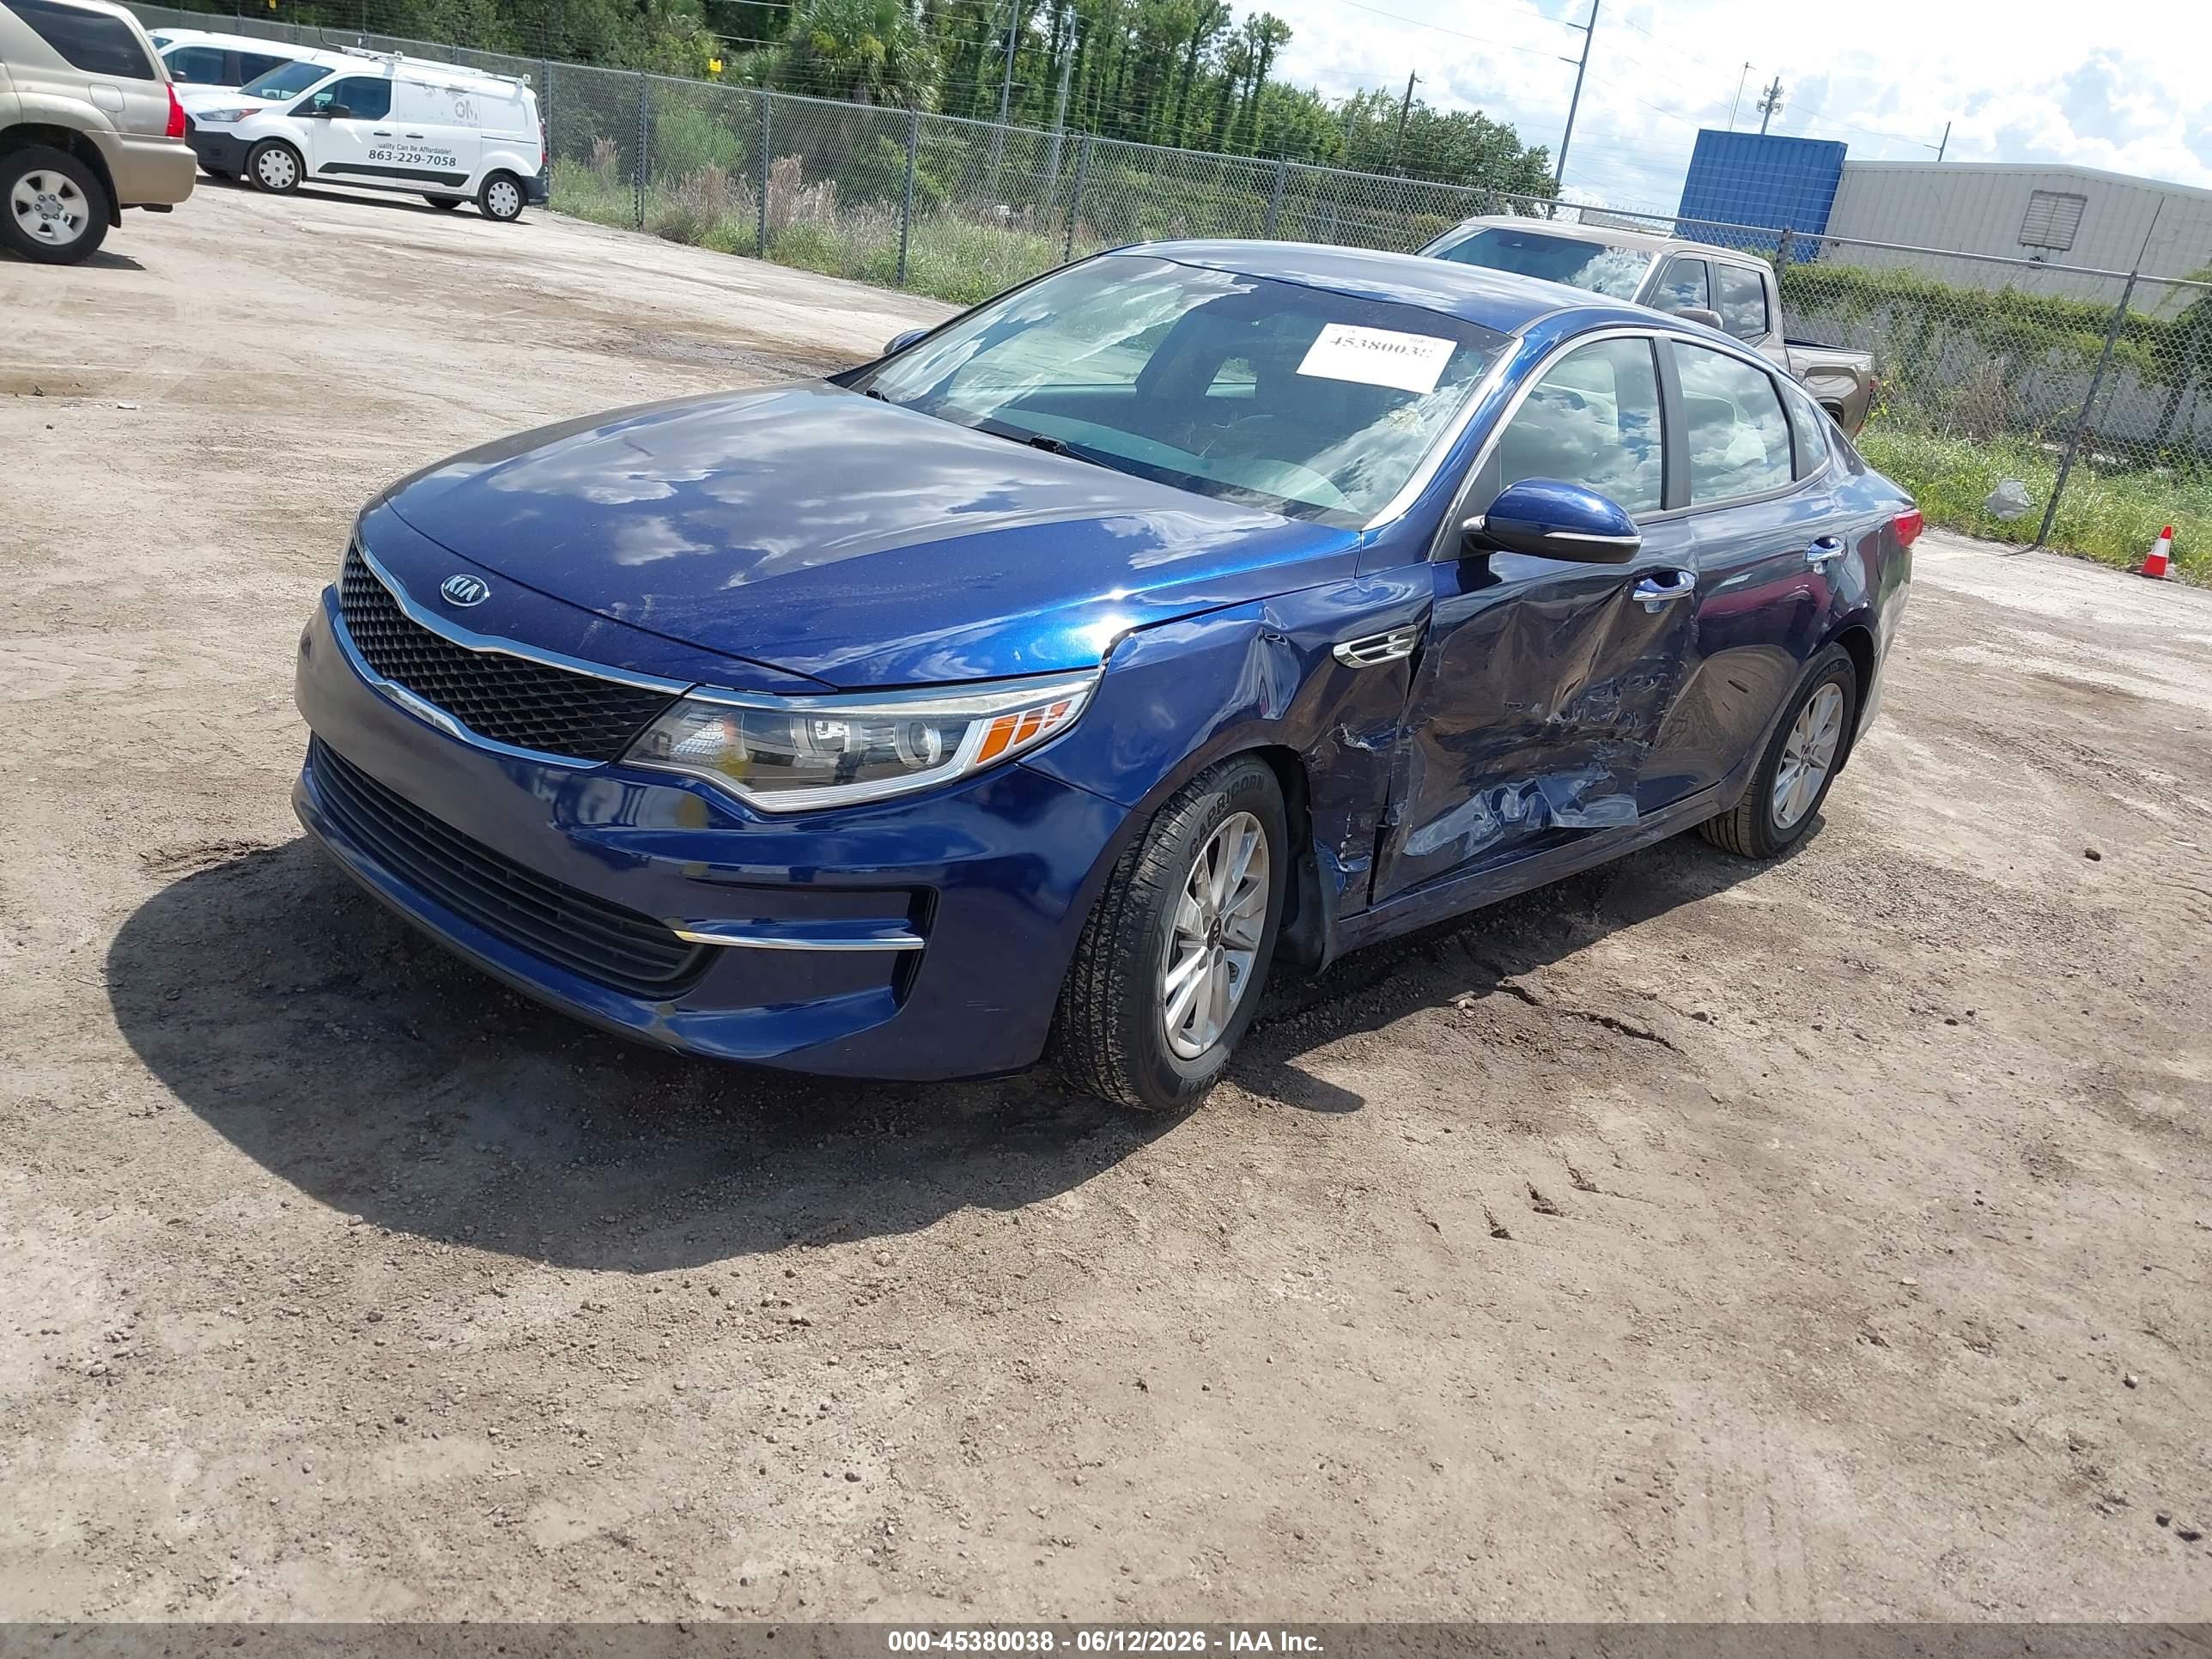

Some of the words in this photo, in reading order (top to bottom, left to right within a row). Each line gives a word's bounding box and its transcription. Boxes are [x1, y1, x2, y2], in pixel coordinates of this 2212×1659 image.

[377, 143, 396, 151] uality
[368, 150, 457, 167] 863-229-7058
[444, 575, 481, 603] KIA
[1188, 775, 1265, 861] CAPRICORN
